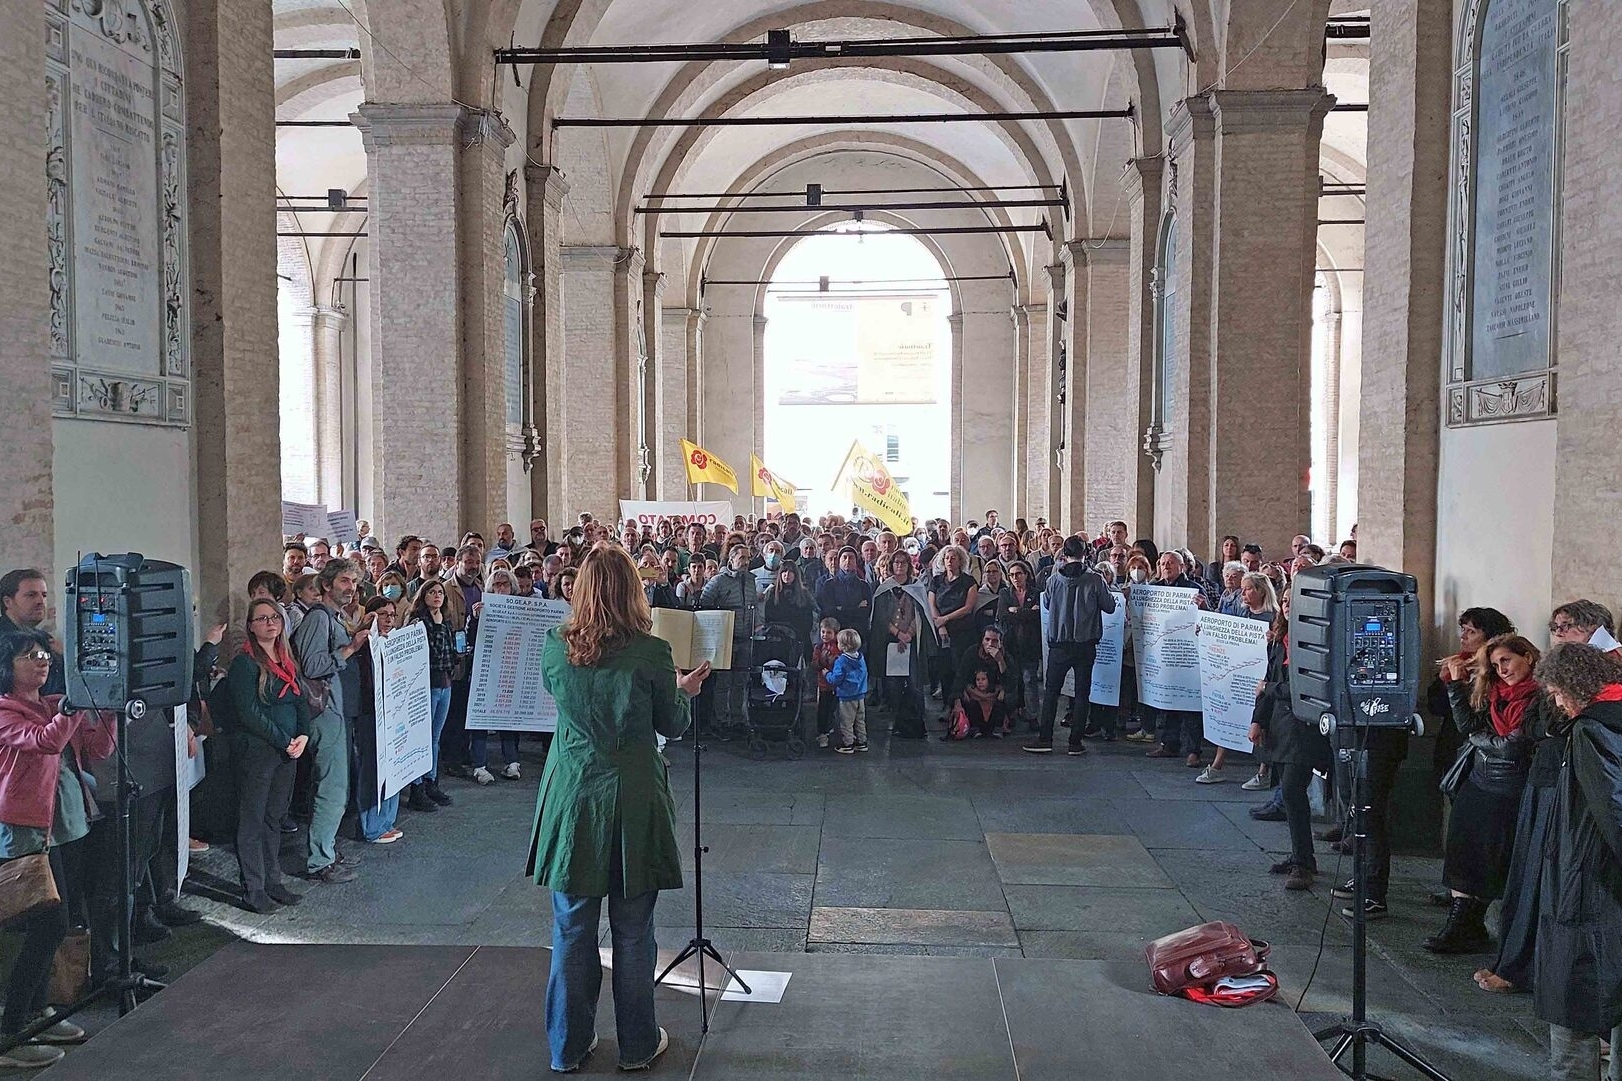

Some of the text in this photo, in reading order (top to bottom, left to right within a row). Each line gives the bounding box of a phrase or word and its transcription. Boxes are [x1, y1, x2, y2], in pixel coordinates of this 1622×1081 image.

[1133, 588, 1165, 598] AEROPORTO
[1172, 591, 1192, 599] PARMA
[1200, 616, 1232, 628] AEROPORTO
[1240, 623, 1263, 633] PARMA
[1204, 625, 1230, 634] LUNGHEZZA
[1231, 629, 1249, 637] DELLA
[1249, 632, 1265, 640] PISTA
[1212, 632, 1228, 640] FALSO
[1228, 634, 1258, 646] PROBLEMA!
